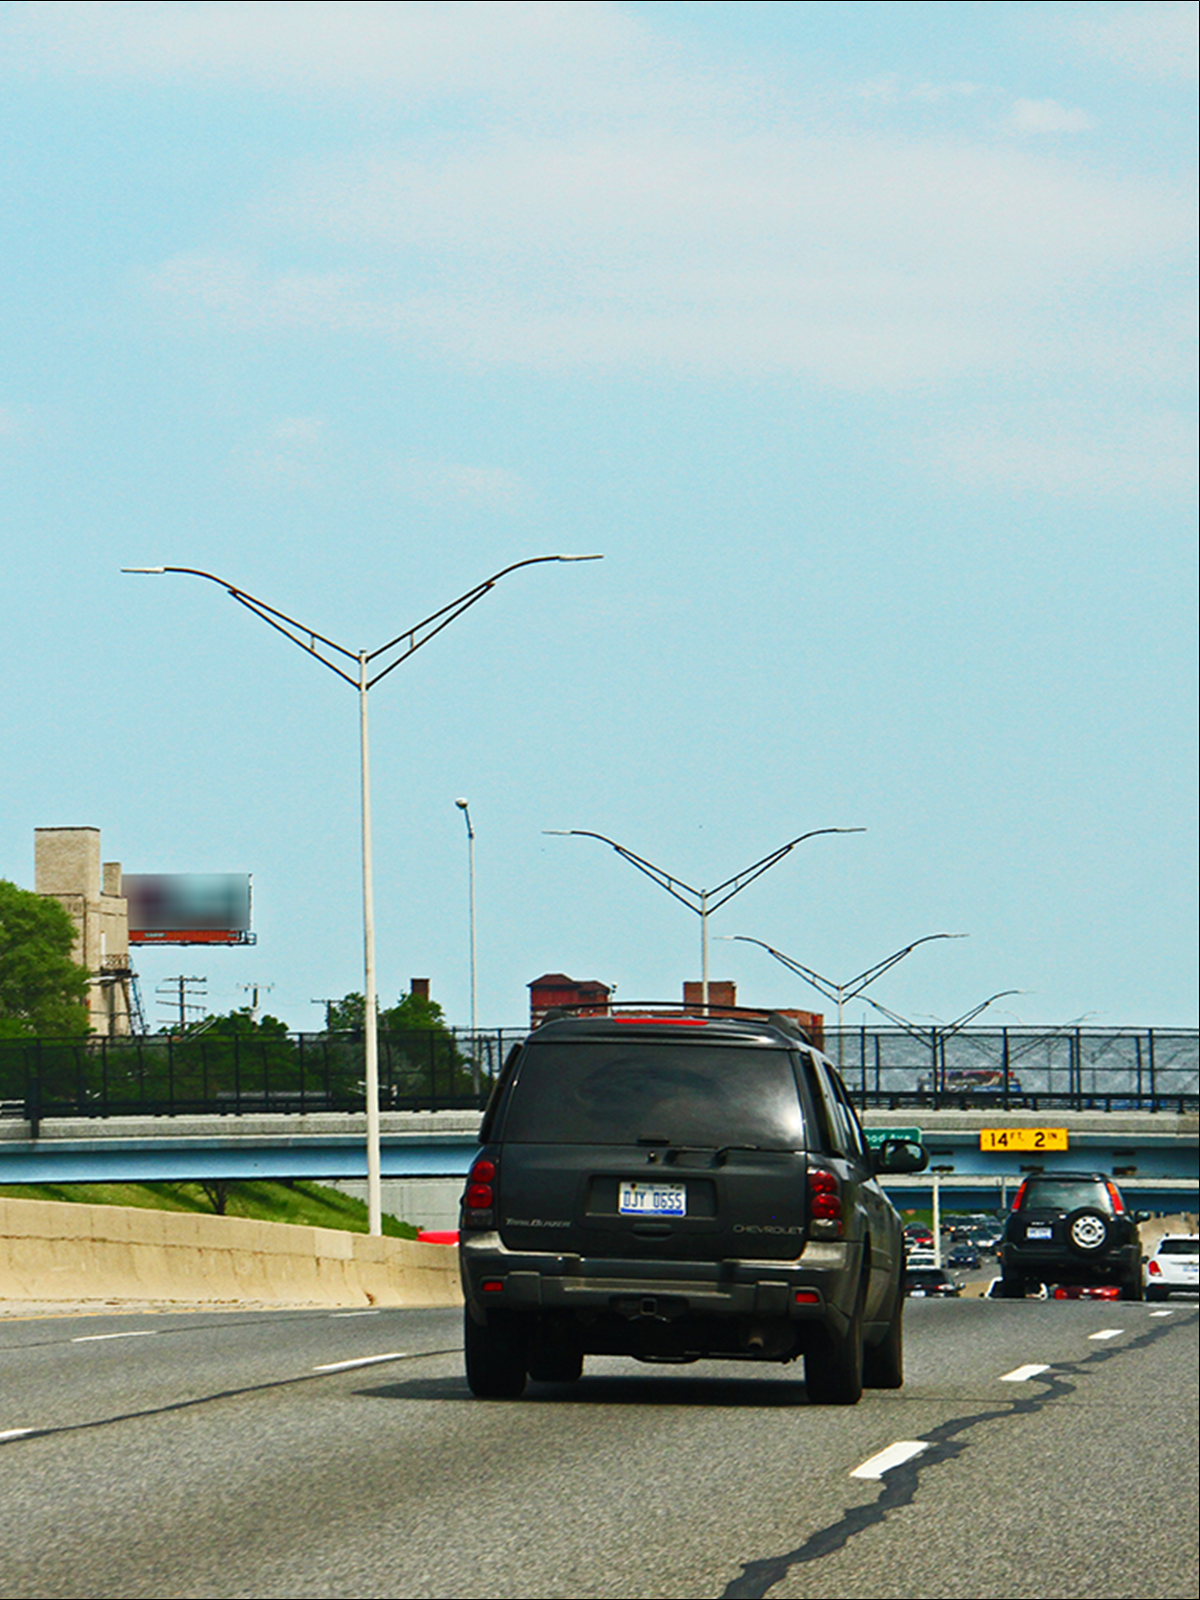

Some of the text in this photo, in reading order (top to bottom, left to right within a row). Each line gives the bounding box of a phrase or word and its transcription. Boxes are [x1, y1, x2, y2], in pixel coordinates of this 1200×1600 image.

[991, 1132, 1008, 1147] 14
[1034, 1131, 1046, 1147] 2
[653, 1191, 683, 1210] 0655
[732, 1224, 805, 1235] CHEVROLET
